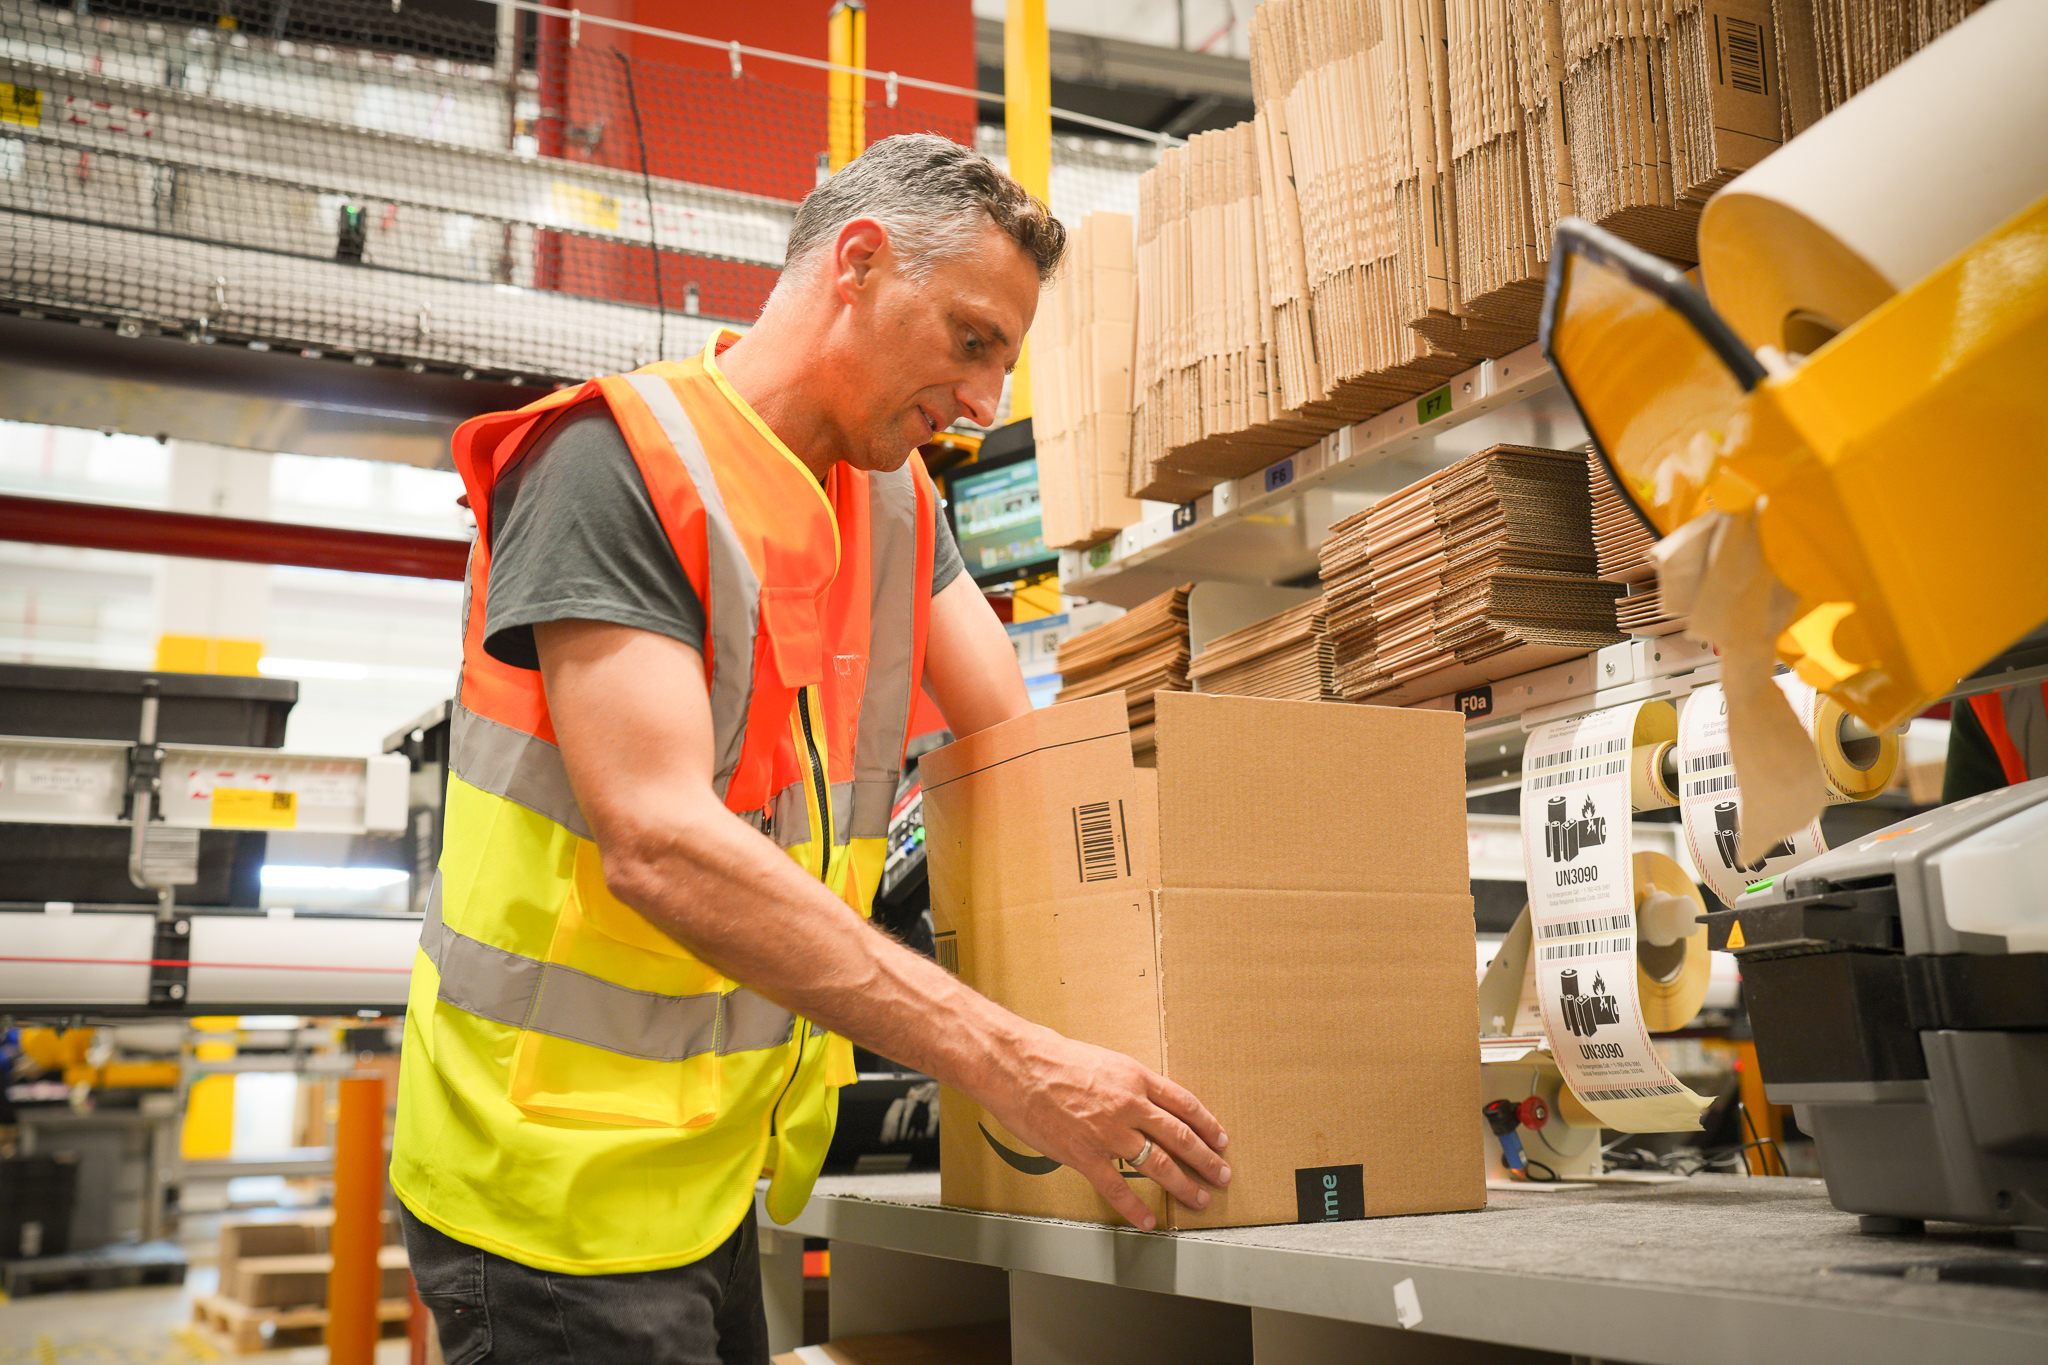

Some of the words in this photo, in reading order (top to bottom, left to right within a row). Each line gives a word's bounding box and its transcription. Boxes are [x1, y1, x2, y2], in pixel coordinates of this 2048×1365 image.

[1426, 395, 1442, 415] F7
[1271, 467, 1287, 486] F6
[1555, 865, 1598, 887] UN3090
[1578, 1043, 1625, 1060] UN3090
